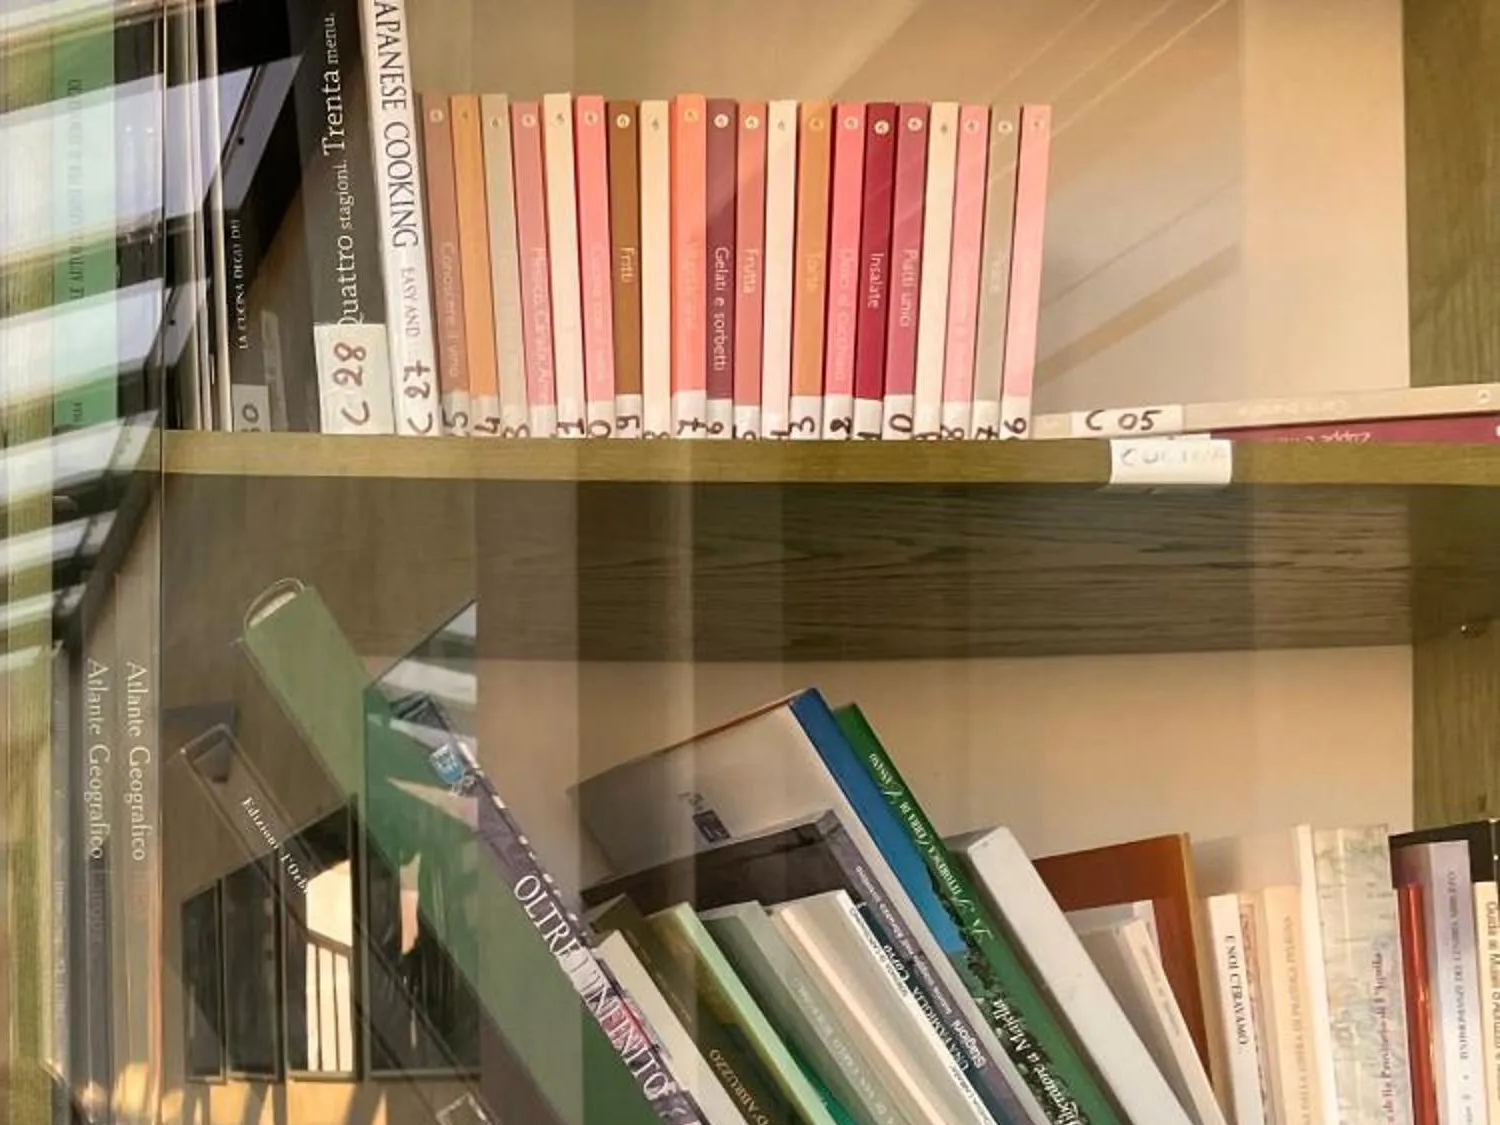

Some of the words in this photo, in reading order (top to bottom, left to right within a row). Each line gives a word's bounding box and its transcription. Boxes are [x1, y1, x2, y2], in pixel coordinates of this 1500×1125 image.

[321, 65, 345, 158] Trenta
[384, 121, 420, 249] COOKING
[714, 247, 729, 291] Gelati
[867, 253, 885, 309] Insalate
[715, 296, 725, 307] e
[332, 341, 367, 388] 28
[713, 314, 725, 372] sorbetti
[1085, 409, 1105, 430] C
[1118, 409, 1161, 430] 05
[87, 659, 109, 735] Atlante
[84, 744, 111, 861] Geografico
[124, 746, 153, 861] Geografico
